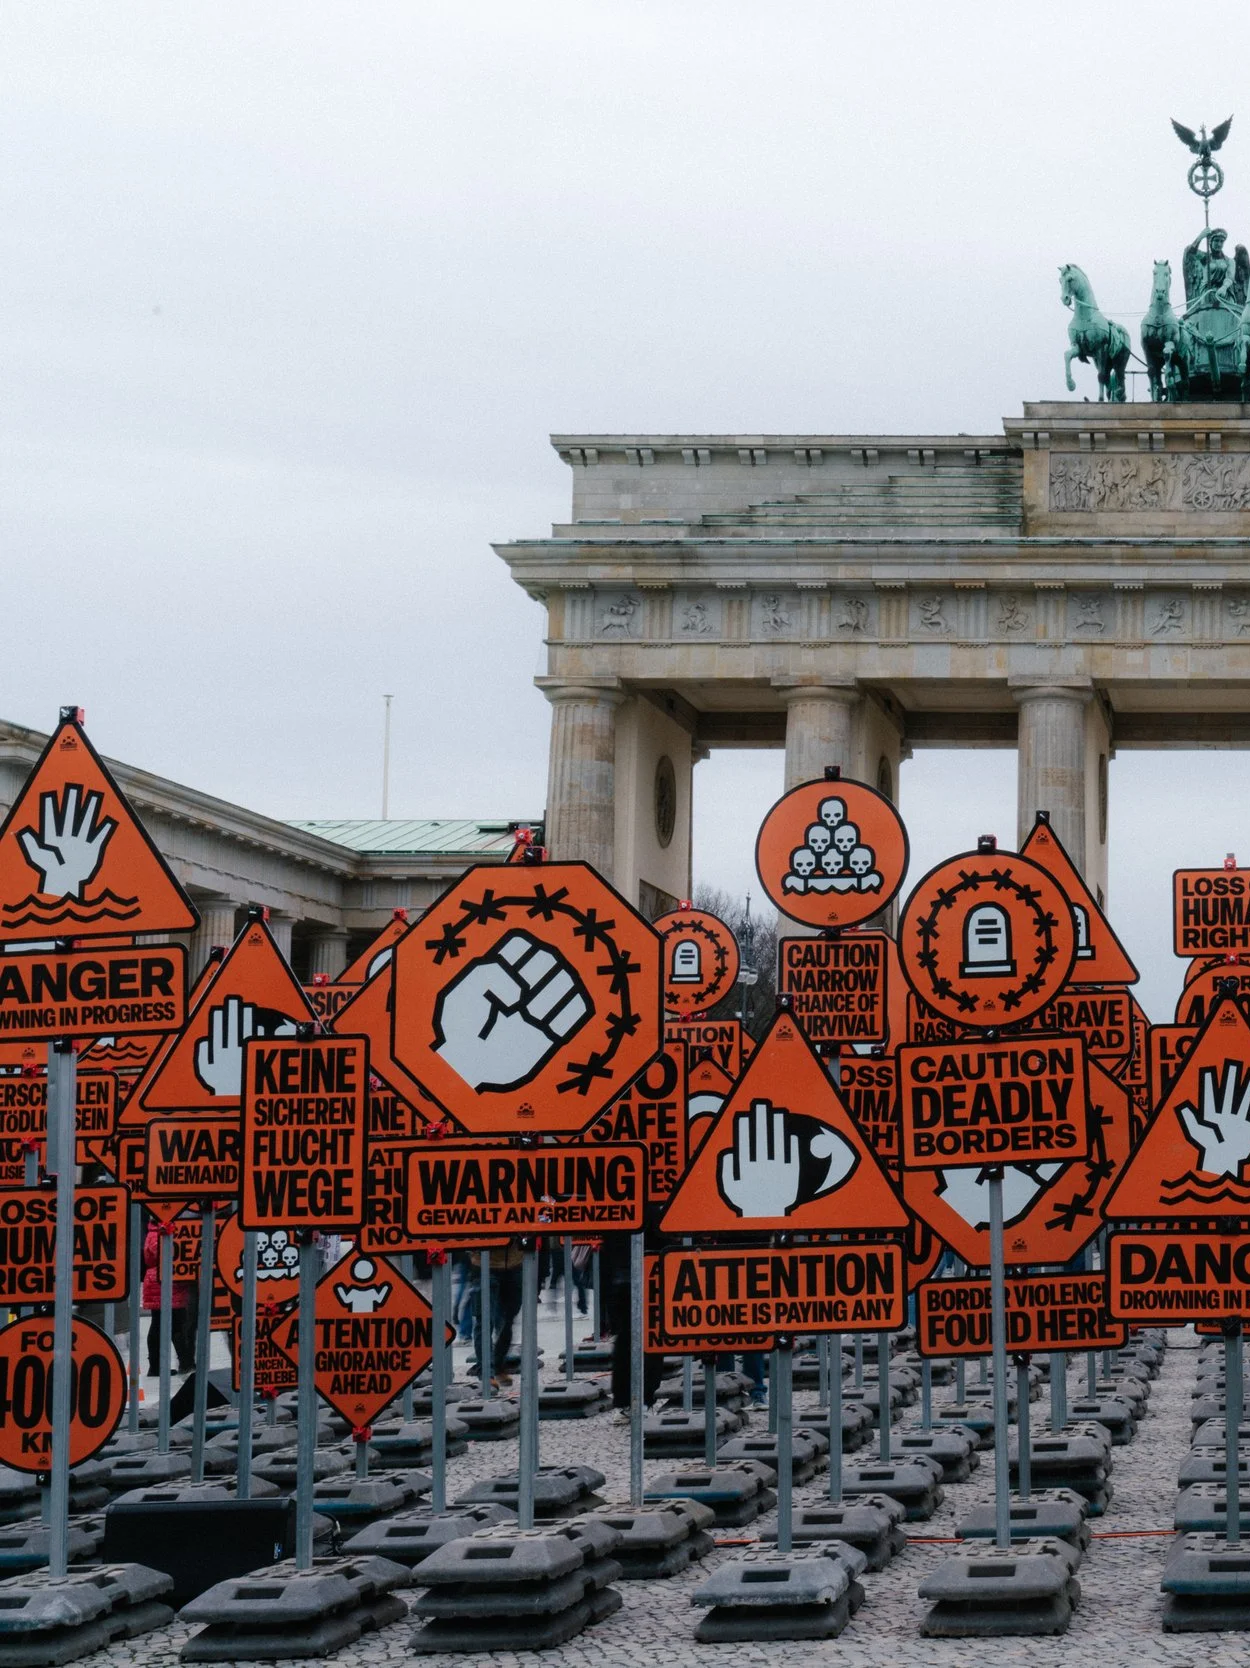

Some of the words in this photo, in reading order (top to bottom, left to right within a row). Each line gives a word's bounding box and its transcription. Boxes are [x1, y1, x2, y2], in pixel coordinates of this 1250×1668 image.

[1182, 876, 1245, 897] LOSS
[787, 943, 880, 969] CAUTION
[0, 957, 175, 1006] ANGER
[787, 969, 879, 993] NARROW
[0, 1006, 56, 1030] WNING
[59, 1005, 78, 1027] IN
[81, 1001, 176, 1026] PROGRESS
[795, 993, 855, 1013] HANCE
[858, 993, 879, 1012] OF
[667, 1026, 735, 1043] UTION
[798, 1014, 880, 1038] URVIVAL
[255, 1047, 357, 1095] KEINE
[619, 1052, 678, 1100] O
[839, 1065, 893, 1087] OSS
[910, 1047, 1075, 1083] CAUTION
[254, 1096, 356, 1126] SICHEREN
[911, 1078, 1075, 1130] DEADLY
[591, 1102, 678, 1141] SAFE
[253, 1128, 355, 1167] FLUCHT
[913, 1124, 1078, 1158] BORDERS
[156, 1164, 238, 1185] NIEMAND
[418, 1154, 636, 1206] WARNUNG
[253, 1169, 354, 1218] WEGE
[0, 1198, 57, 1225] OS
[74, 1195, 118, 1222] OF
[417, 1207, 502, 1227] GEWALT
[504, 1206, 535, 1225] AN
[538, 1204, 636, 1224] GRENZEN
[671, 1252, 895, 1302] ATTENTION
[1014, 1281, 1107, 1308] VIOLENC
[1119, 1289, 1221, 1310] DROWNING
[1224, 1289, 1243, 1310] IN
[672, 1305, 701, 1328] NO
[705, 1303, 748, 1326] ONE
[752, 1302, 771, 1325] IS
[775, 1299, 848, 1324] PAYING
[851, 1298, 895, 1322] ANY
[285, 1317, 433, 1349] ATENTION
[315, 1350, 412, 1374] GNORANCE
[330, 1373, 392, 1396] AHEAD
